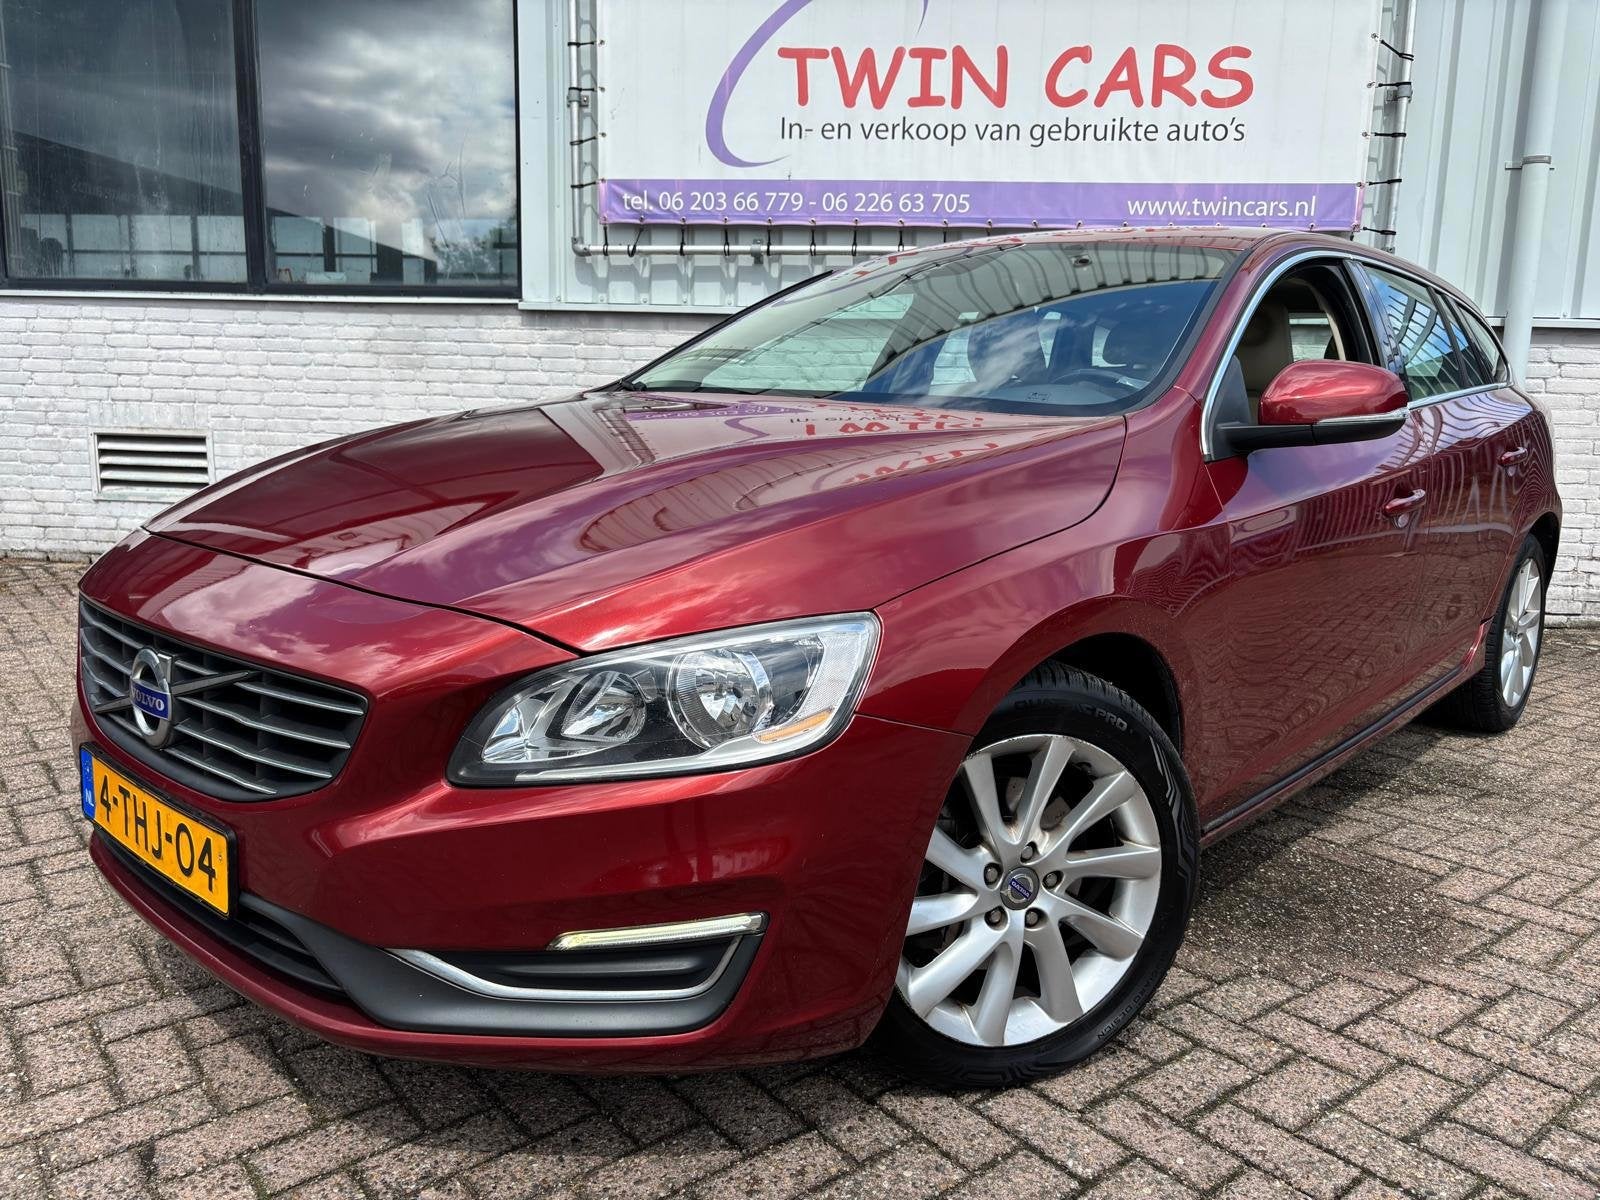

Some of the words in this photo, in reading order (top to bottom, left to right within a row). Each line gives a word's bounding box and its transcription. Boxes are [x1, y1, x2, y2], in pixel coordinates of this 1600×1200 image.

[778, 45, 1008, 109] TWIN
[1045, 44, 1254, 108] CARS
[780, 116, 813, 140] In-
[821, 122, 852, 140] en
[860, 116, 967, 147] verkoop
[974, 123, 1021, 141] van
[1029, 116, 1159, 148] gebruikte
[1166, 116, 1245, 142] auto’s
[622, 190, 654, 211] tel.
[659, 191, 684, 211] 06
[690, 191, 727, 211] 203
[733, 191, 759, 211] 66
[765, 192, 803, 212] 779
[822, 192, 848, 212] 06
[854, 192, 893, 212] 226
[899, 193, 924, 213] 63
[932, 193, 970, 213] 705
[1127, 195, 1316, 217] www.twincars.nl
[131, 686, 165, 711] VOLVO
[1094, 708, 1128, 732] PRO
[85, 788, 95, 807] NL
[99, 774, 217, 893] 4-THJ-04
